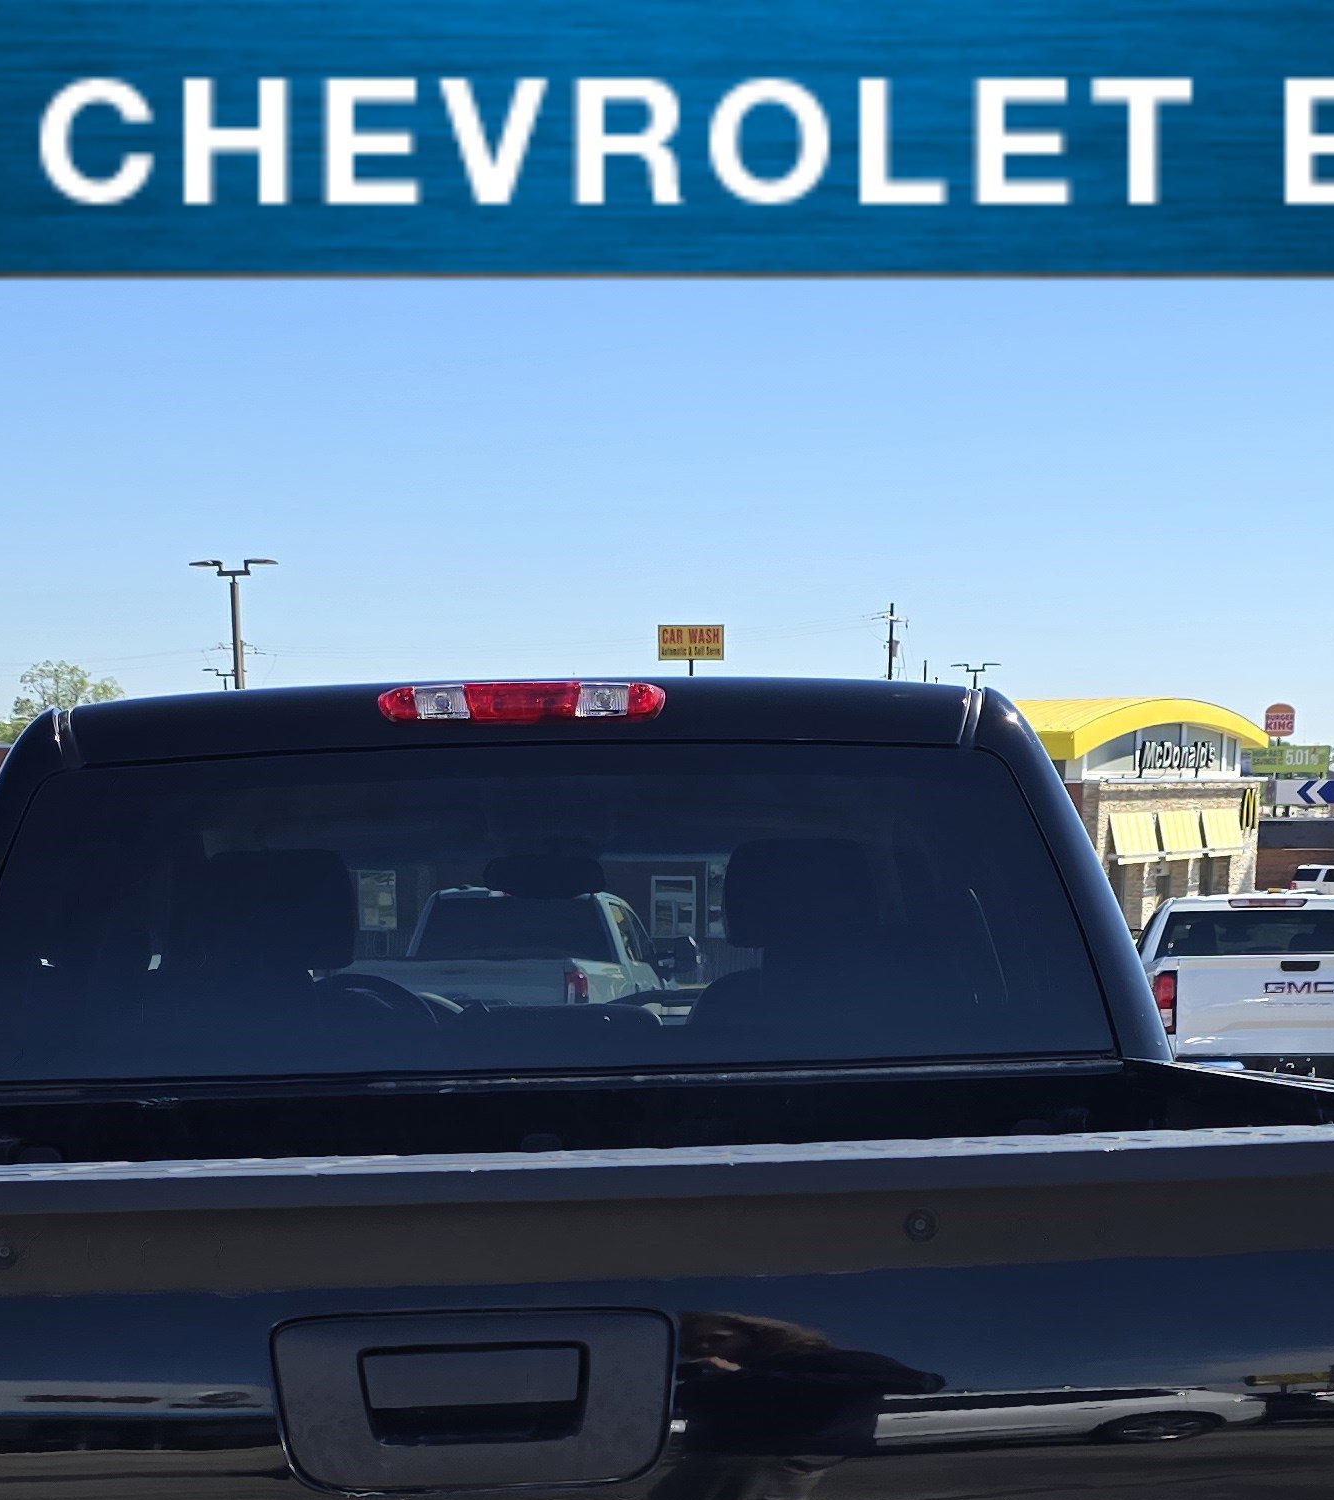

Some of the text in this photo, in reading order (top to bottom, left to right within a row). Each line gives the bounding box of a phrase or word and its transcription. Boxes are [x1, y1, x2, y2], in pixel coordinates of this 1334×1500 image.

[662, 628, 720, 644] CAR WASH
[1267, 713, 1295, 722] BURGER
[1267, 721, 1295, 732] KING
[1140, 740, 1216, 769] McDonald's
